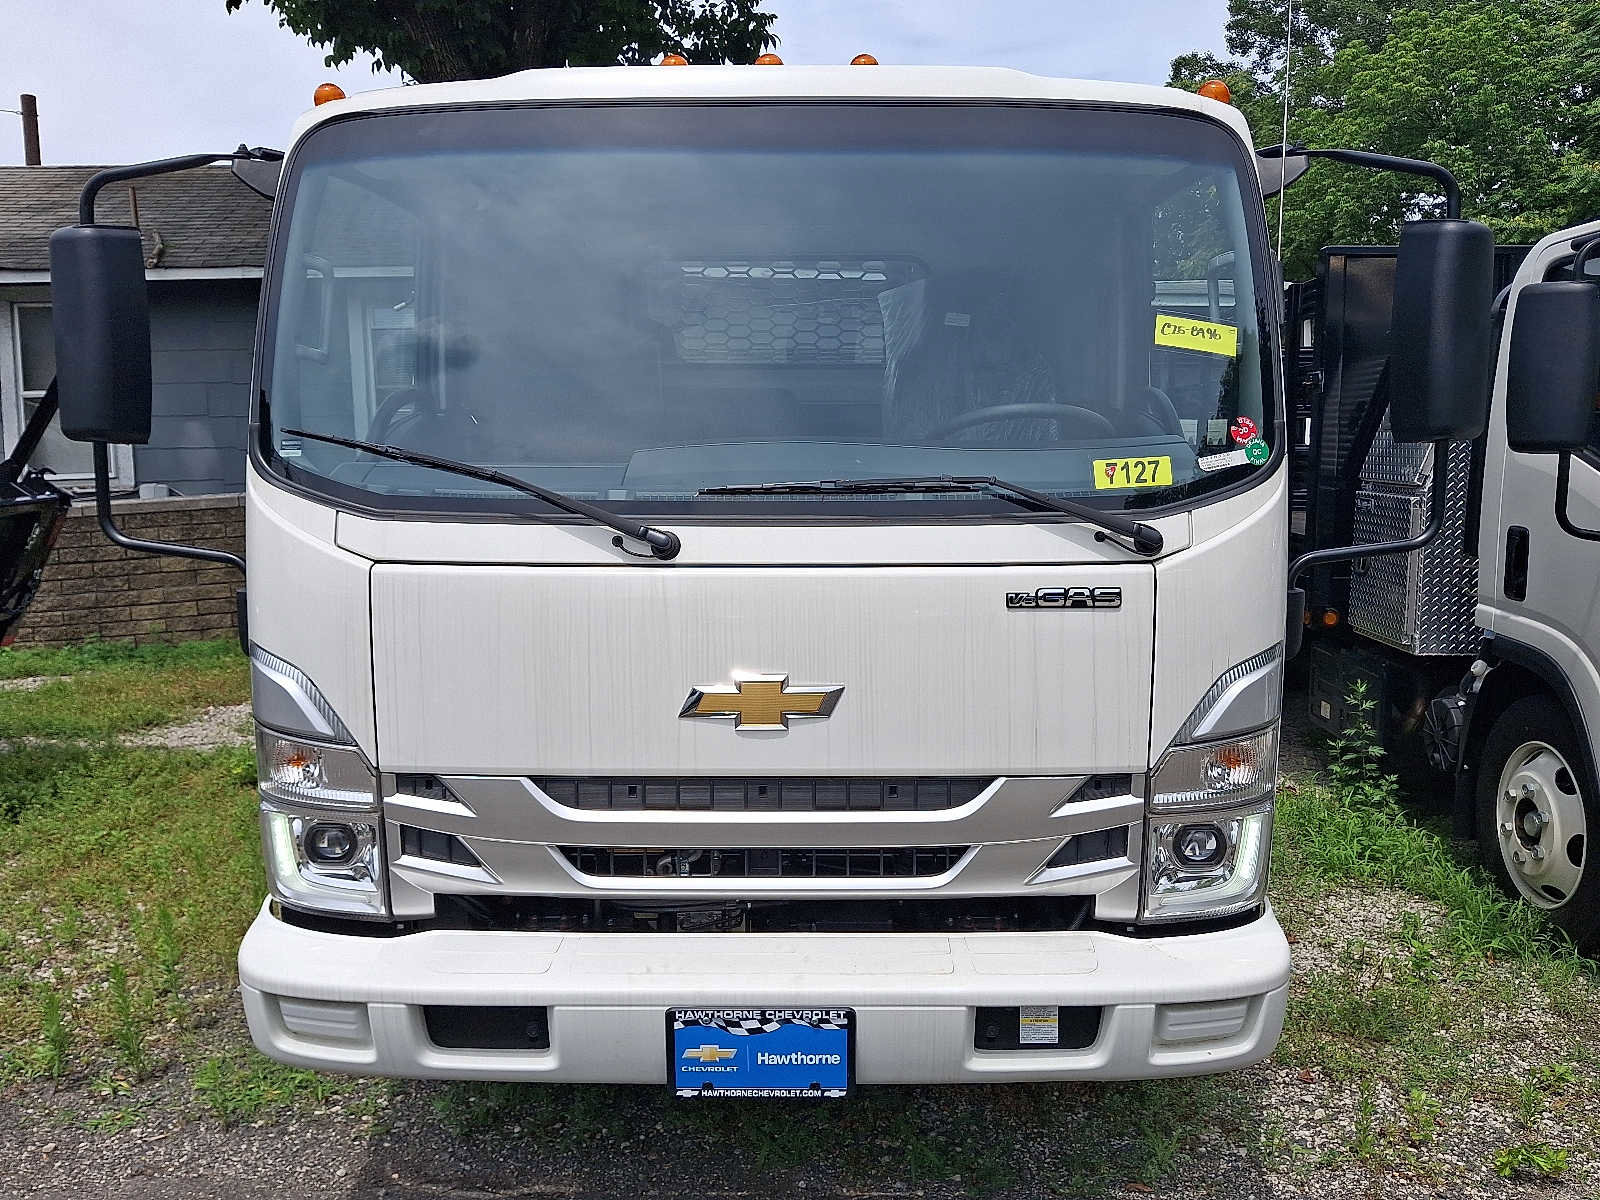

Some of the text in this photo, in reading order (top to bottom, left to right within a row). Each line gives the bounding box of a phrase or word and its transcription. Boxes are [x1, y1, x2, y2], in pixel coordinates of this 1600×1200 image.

[1252, 448, 1262, 456] QC
[1036, 586, 1122, 608] GAS
[675, 1010, 847, 1020] HAWTHORNE CHEVROLET
[757, 1052, 841, 1065] Hawthorne
[681, 1065, 739, 1073] CHEVROLET
[701, 1089, 822, 1098] HAWTHORNECHEVROLET.COM
